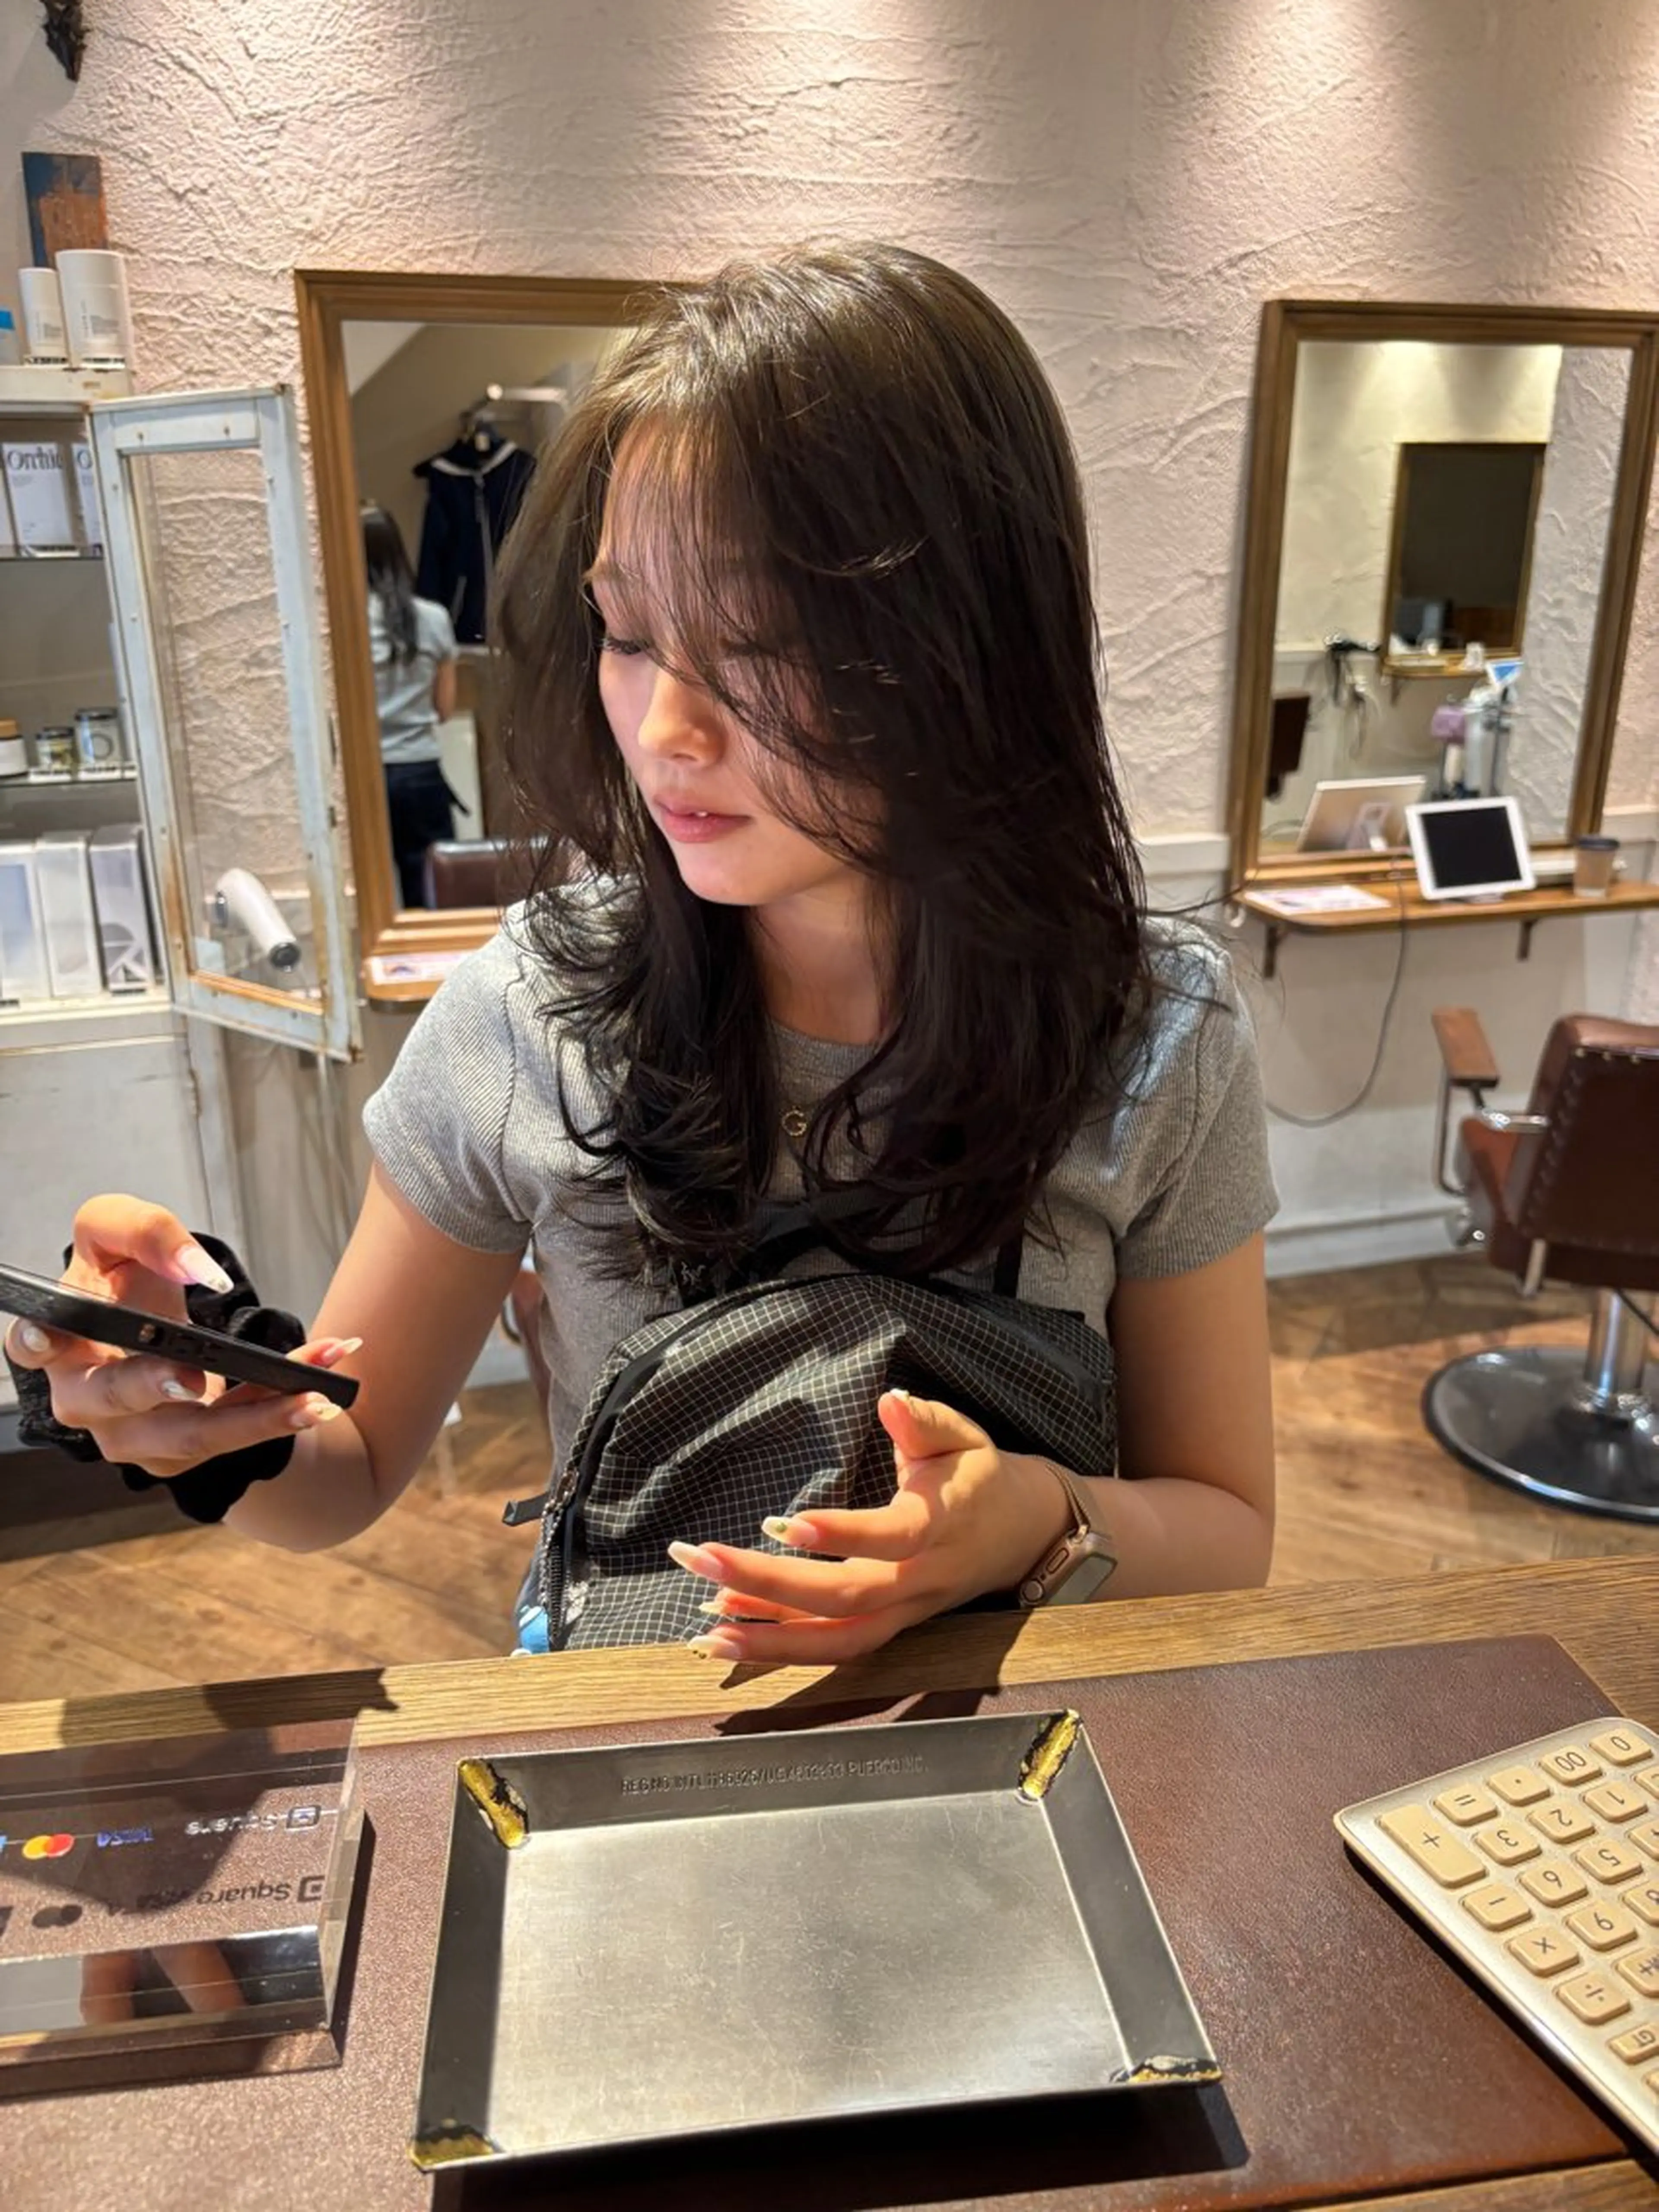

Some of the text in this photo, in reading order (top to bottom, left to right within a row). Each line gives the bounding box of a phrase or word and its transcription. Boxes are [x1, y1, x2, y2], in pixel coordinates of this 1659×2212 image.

[1610, 1735, 1631, 1751] 0
[1554, 1751, 1586, 1772] 00
[1606, 1790, 1625, 1805] 1
[1551, 1808, 1573, 1827] 2
[1496, 1829, 1519, 1847] 3
[1598, 1848, 1621, 1867] 5
